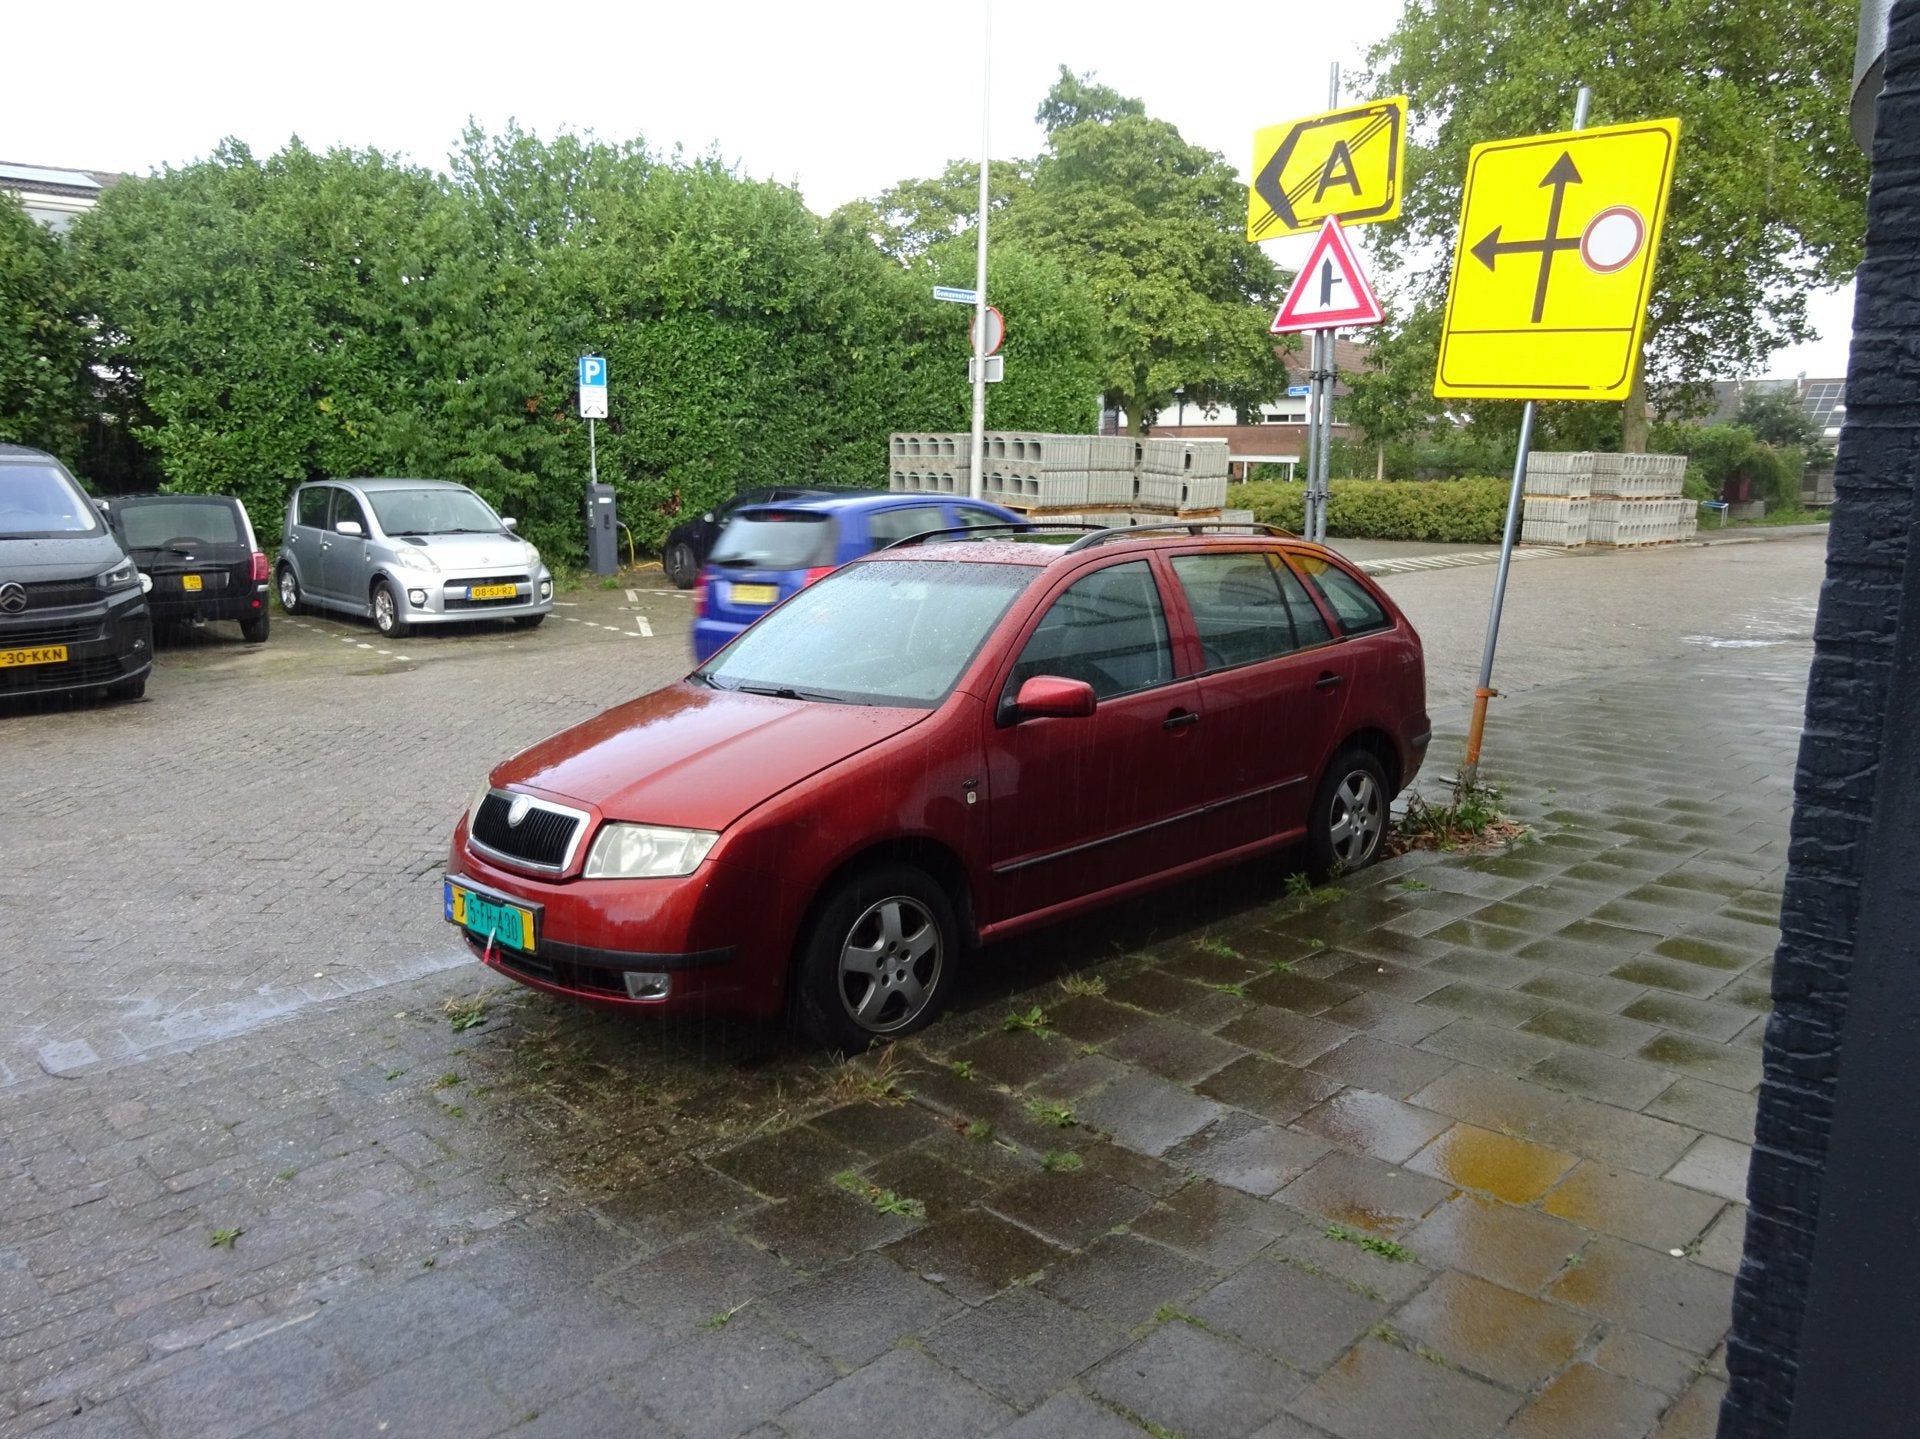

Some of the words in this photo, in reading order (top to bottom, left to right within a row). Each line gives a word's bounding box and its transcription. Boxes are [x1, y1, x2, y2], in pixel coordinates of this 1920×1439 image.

[1312, 140, 1362, 204] A
[585, 361, 600, 384] P
[474, 586, 513, 597] 08-SJ-RZ
